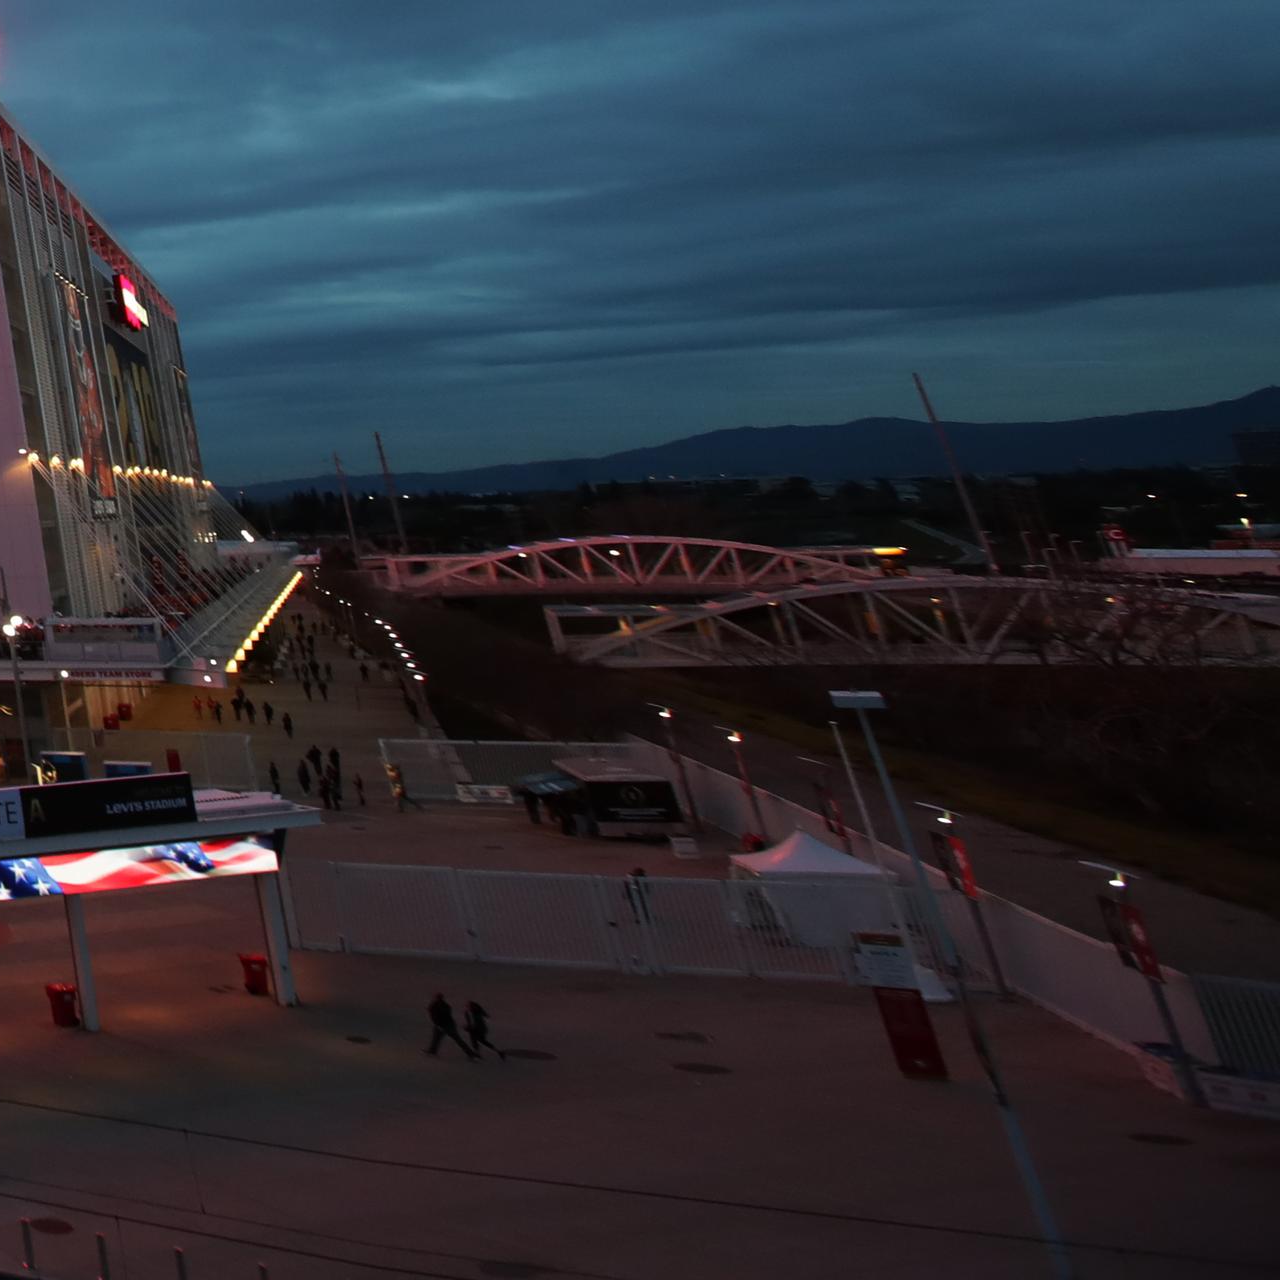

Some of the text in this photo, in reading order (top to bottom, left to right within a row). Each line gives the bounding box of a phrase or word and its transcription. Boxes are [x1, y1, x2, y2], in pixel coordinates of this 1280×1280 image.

[99, 670, 123, 678] TEAM
[126, 670, 153, 678] STORE
[144, 798, 187, 812] STADIUM
